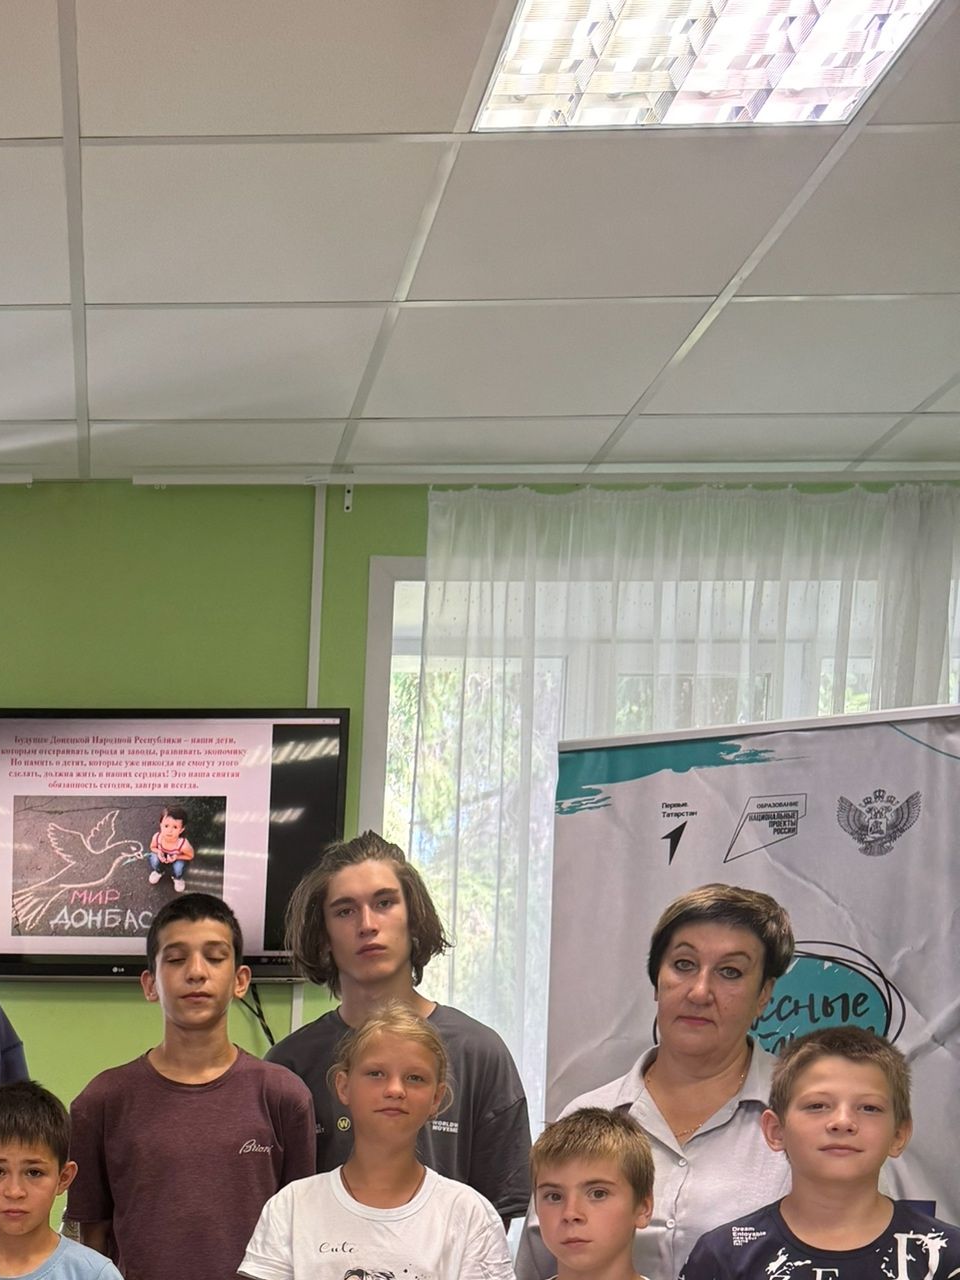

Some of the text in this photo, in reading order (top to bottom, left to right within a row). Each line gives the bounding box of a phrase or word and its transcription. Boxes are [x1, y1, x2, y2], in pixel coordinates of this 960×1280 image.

[134, 735, 182, 746] Республики
[756, 801, 799, 809] ОБРАЗОВАНИЕ
[661, 811, 698, 819] Татарстан
[768, 820, 797, 828] ПРОЕКТЫ
[70, 888, 121, 905] МИР
[48, 905, 153, 931] ДОНБАС
